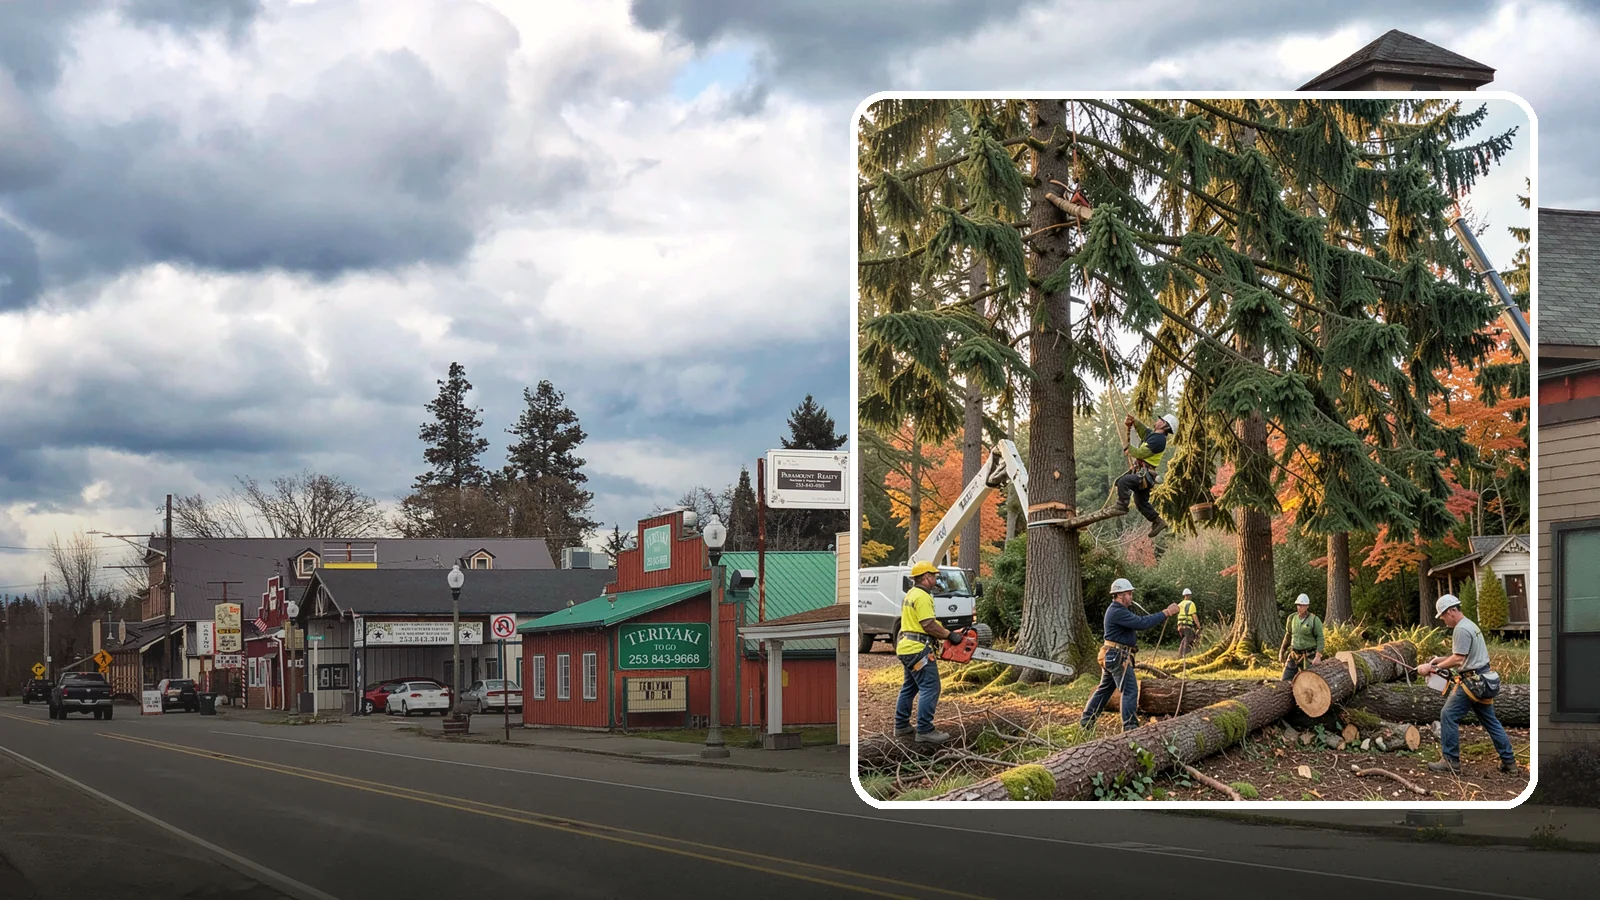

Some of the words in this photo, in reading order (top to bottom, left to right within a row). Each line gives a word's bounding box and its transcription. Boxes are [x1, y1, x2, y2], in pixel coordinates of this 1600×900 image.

[625, 627, 702, 646] TERIYAKI
[629, 654, 648, 664] 253
[651, 653, 700, 664] 843-9668
